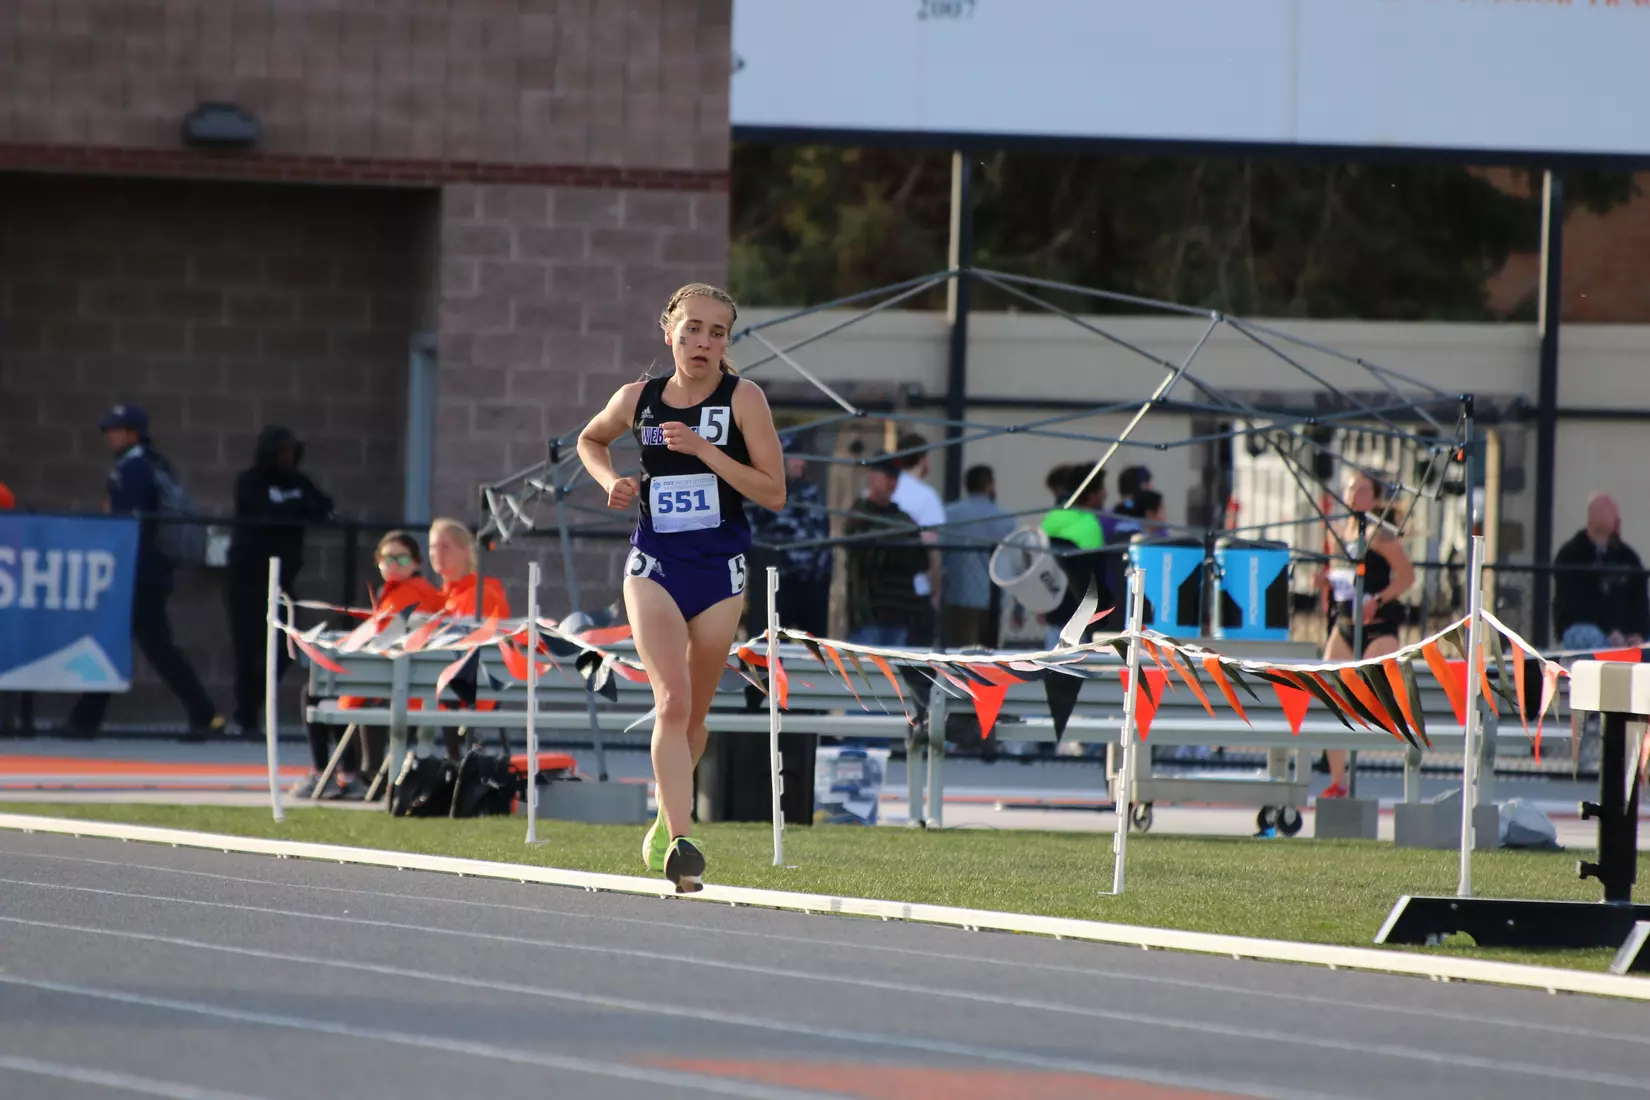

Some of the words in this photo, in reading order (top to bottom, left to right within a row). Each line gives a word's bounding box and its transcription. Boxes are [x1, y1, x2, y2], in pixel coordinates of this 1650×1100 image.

[641, 426, 666, 445] WEB
[706, 409, 723, 443] 5
[658, 489, 711, 514] 551
